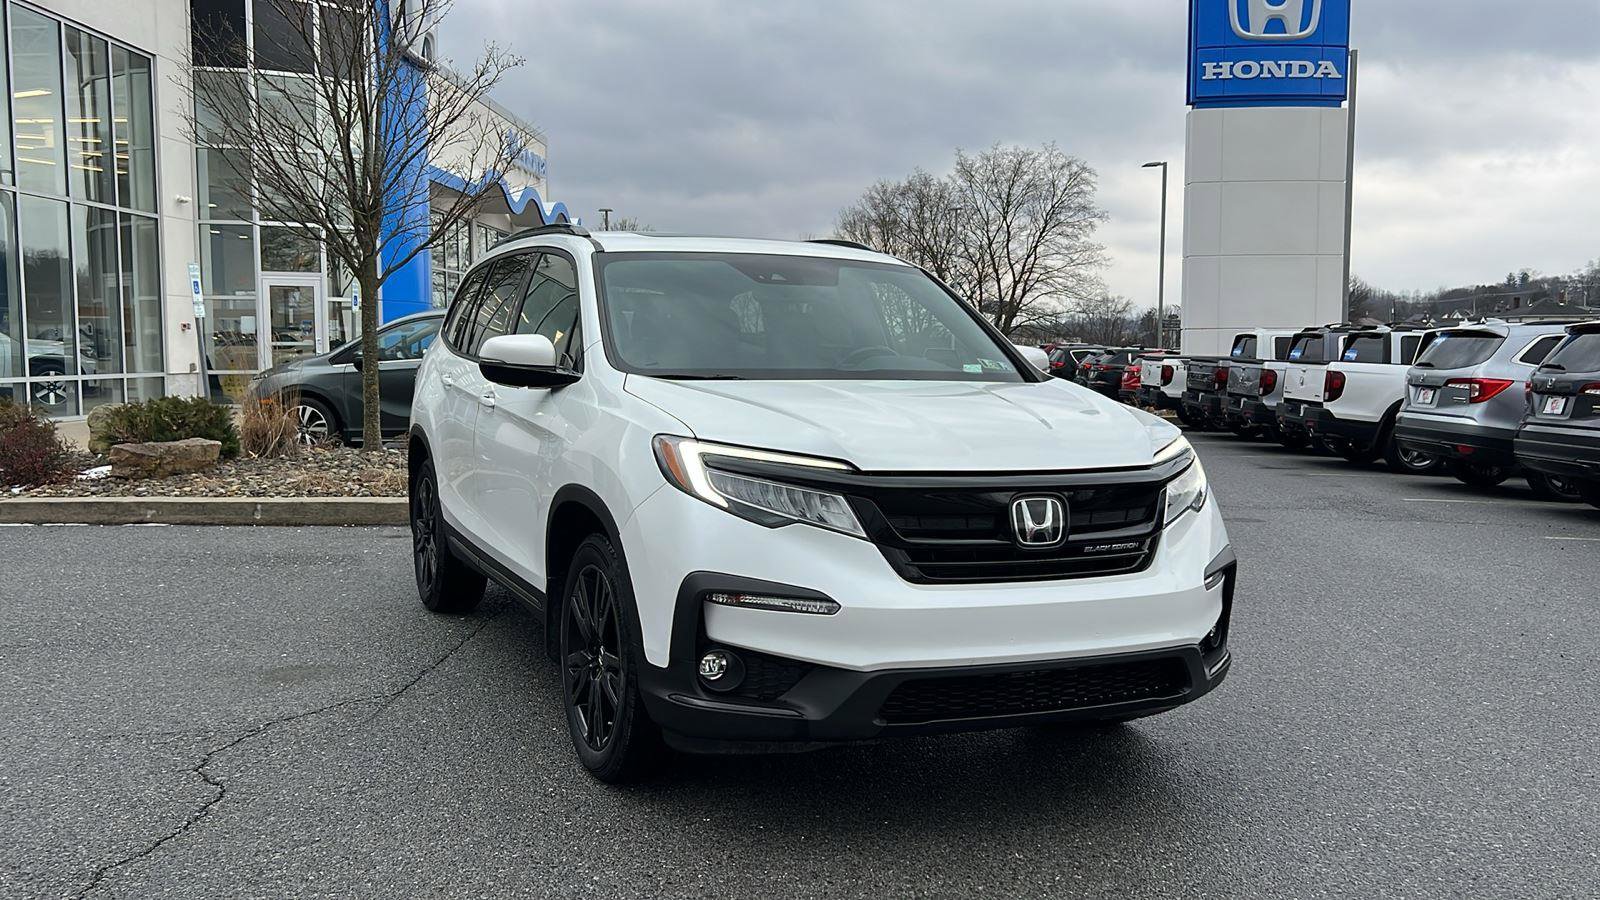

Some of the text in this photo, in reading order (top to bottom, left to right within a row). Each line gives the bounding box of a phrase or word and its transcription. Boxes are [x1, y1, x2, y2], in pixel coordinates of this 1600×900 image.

[1202, 60, 1342, 80] HONDA
[1083, 542, 1139, 553] BLACK EDITION
